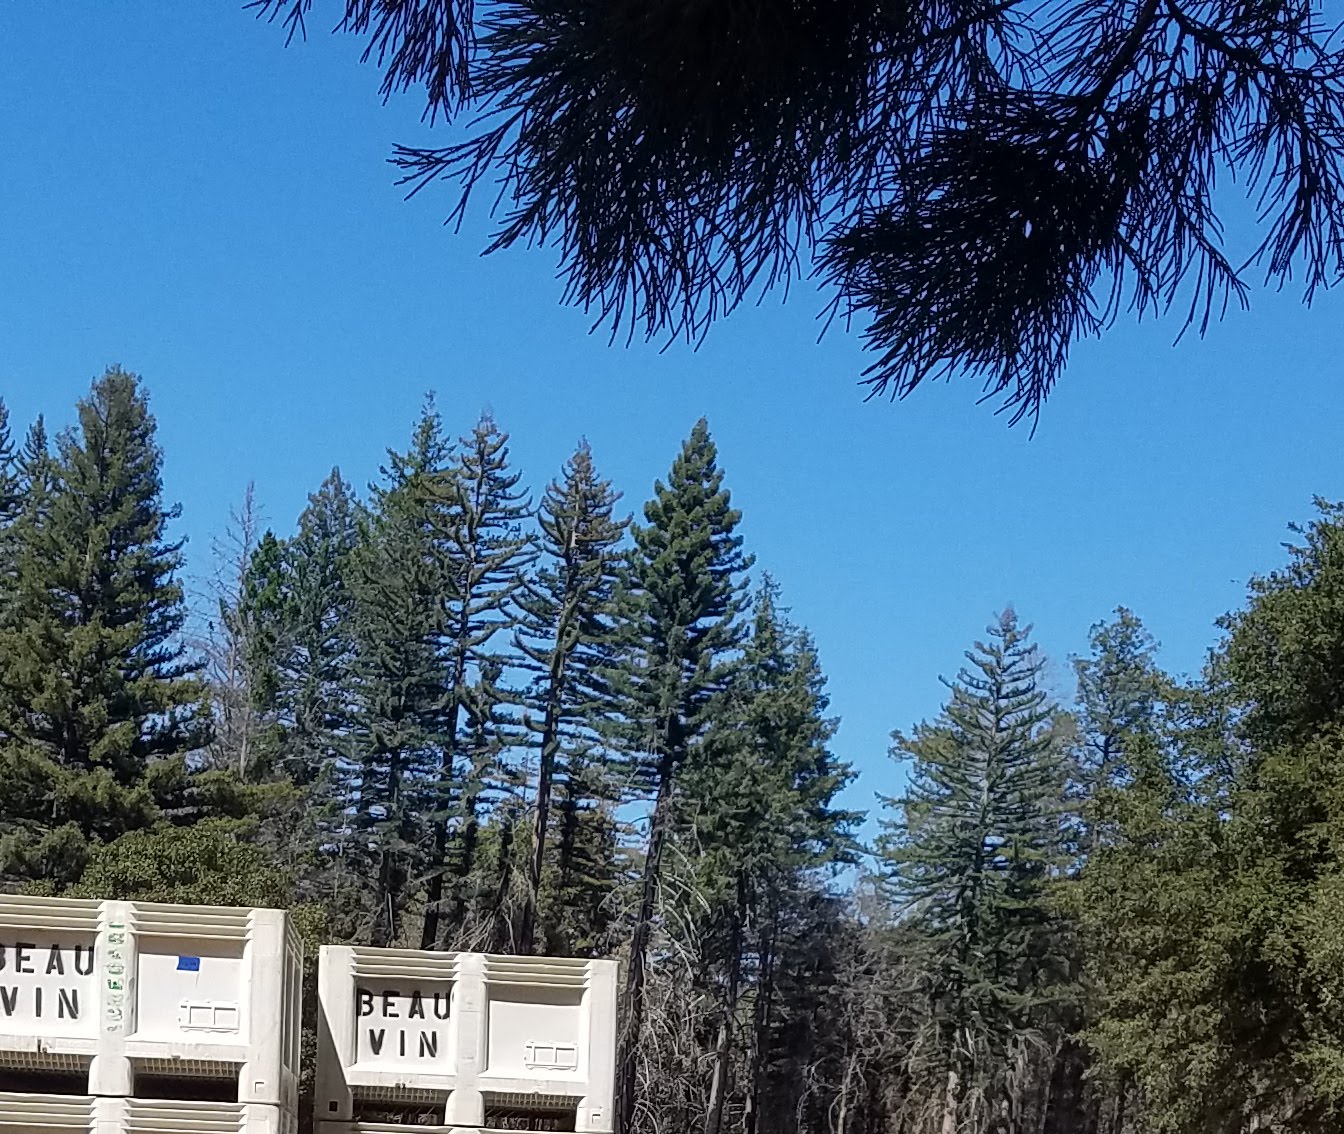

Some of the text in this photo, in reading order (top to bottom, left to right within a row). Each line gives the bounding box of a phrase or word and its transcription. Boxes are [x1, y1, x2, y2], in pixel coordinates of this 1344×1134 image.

[0, 985, 79, 1020] VIN
[356, 987, 451, 1020] BEAU
[368, 1028, 437, 1058] VIN
